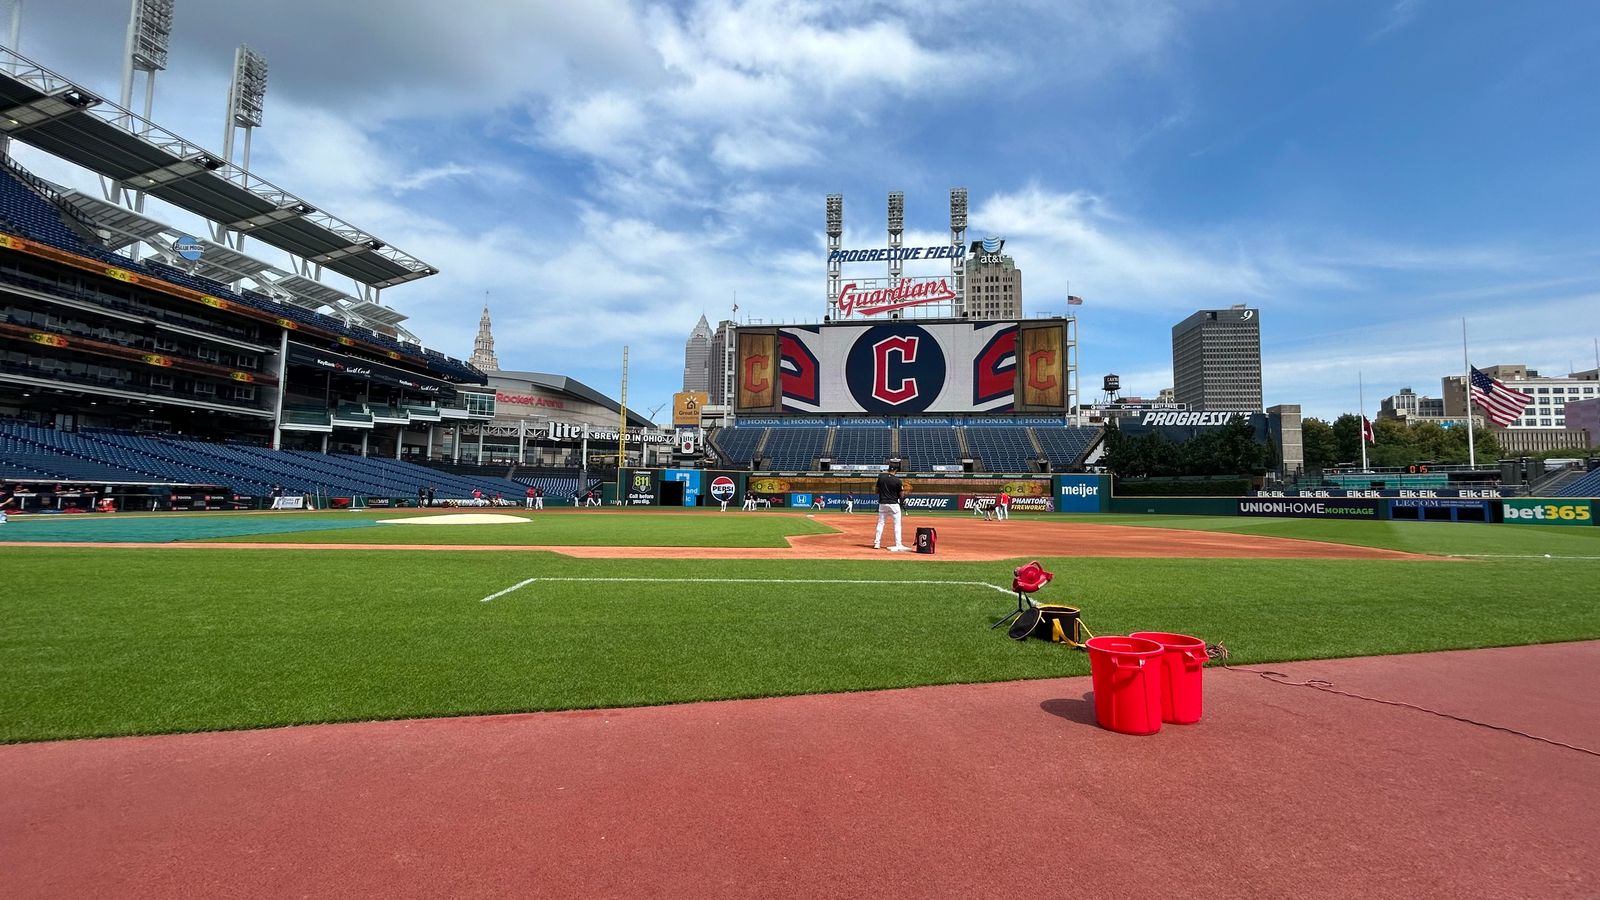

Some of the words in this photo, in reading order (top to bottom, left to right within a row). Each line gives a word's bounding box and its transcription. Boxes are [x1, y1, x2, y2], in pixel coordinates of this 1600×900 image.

[828, 247, 922, 262] PROGRESSIVE
[924, 246, 966, 260] FIELD
[980, 254, 1004, 263] at&t
[838, 278, 956, 318] Guardians
[744, 354, 769, 393] C
[872, 335, 919, 406] C
[1028, 350, 1056, 390] C
[496, 392, 534, 405] Rocket
[536, 398, 564, 408] Arena
[1142, 412, 1252, 425] PROGRESSIE
[548, 421, 581, 441] Lite
[594, 432, 630, 441] BREWED
[635, 476, 648, 486] 811
[1062, 484, 1098, 496] meijer
[1504, 504, 1591, 520] bet365
[919, 534, 927, 547] C
